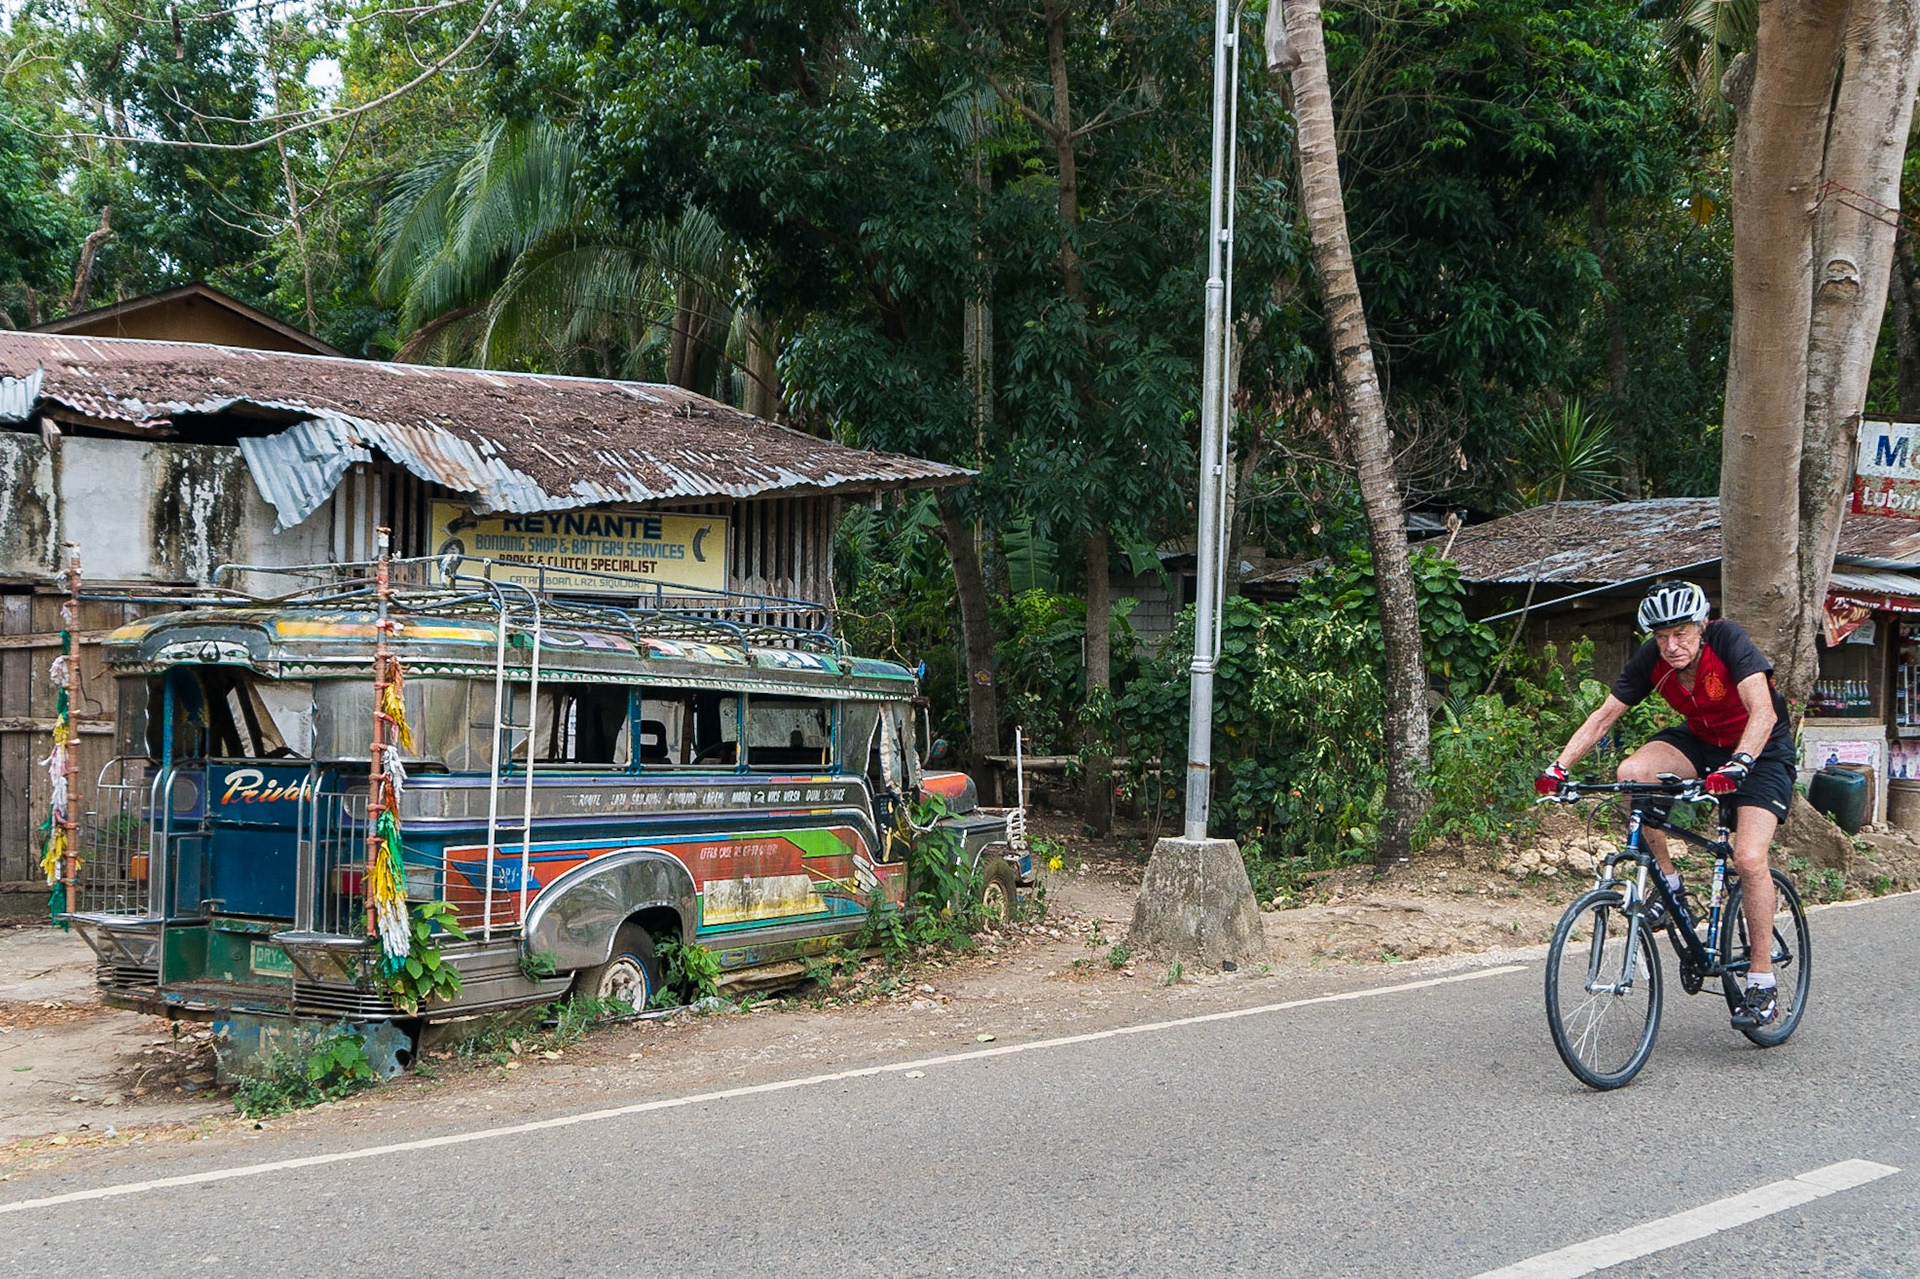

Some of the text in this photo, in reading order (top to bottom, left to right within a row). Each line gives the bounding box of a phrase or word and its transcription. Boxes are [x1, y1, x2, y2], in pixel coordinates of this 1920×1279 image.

[503, 513, 662, 540] REYNANTE
[475, 533, 685, 560] BONDING SHOP & BATTERY SERVICES
[547, 556, 588, 571] CLUTCH
[590, 558, 658, 574] SPECIALIST
[767, 790, 781, 803] VICE
